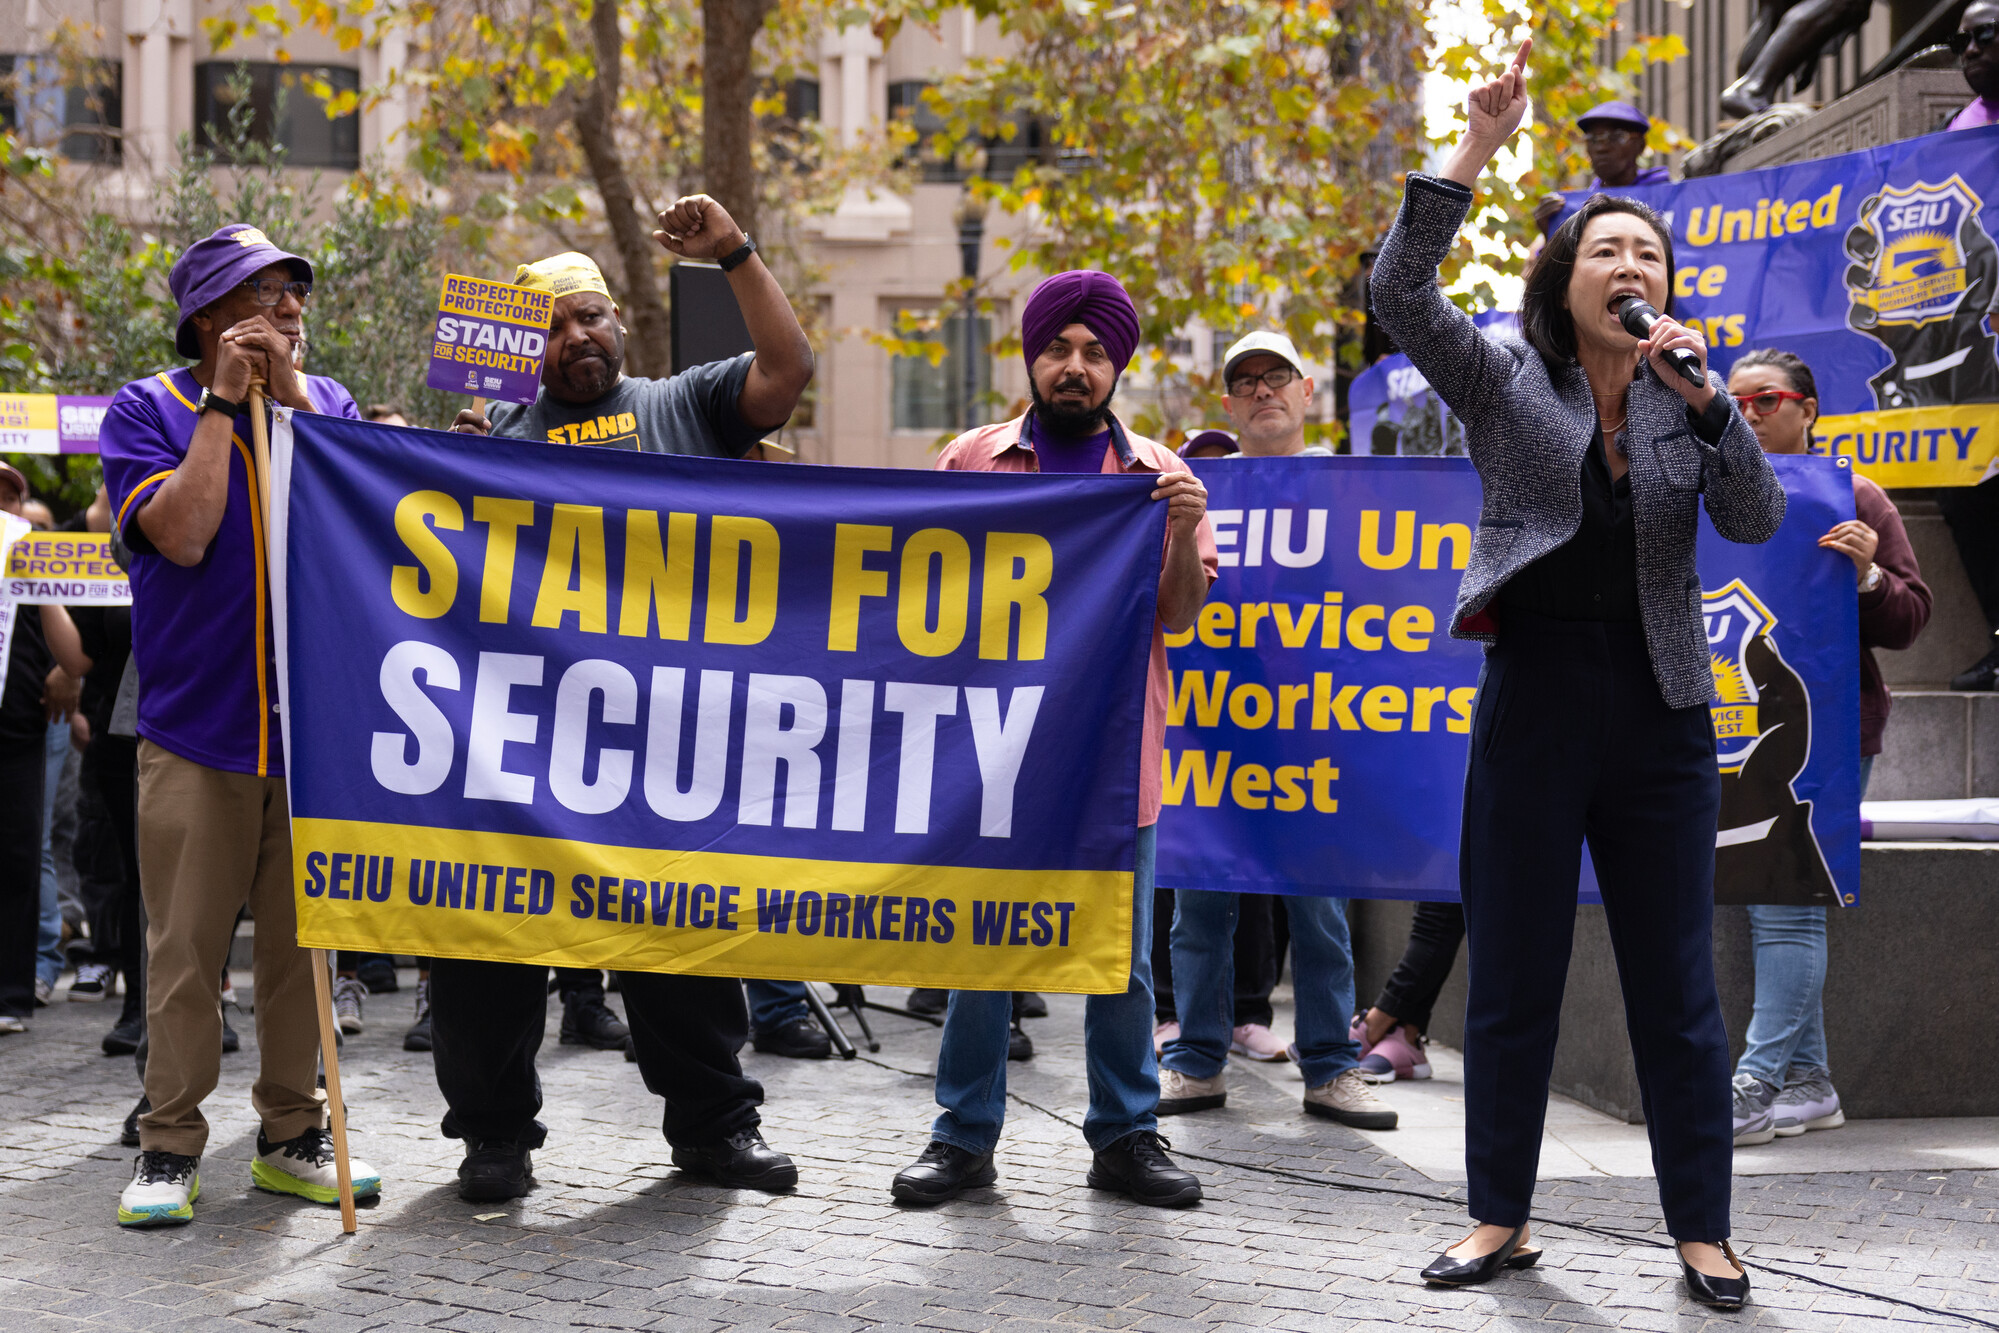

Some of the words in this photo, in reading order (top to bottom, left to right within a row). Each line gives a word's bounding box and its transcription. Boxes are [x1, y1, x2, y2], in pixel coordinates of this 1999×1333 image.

[1686, 183, 1843, 247] United
[1886, 201, 1951, 232] SEIU
[447, 278, 518, 303] RESPECT
[521, 291, 551, 309] THE
[1879, 290, 1929, 309] WORKERS
[1932, 283, 1957, 295] WEST
[1917, 273, 1957, 290] SERVICE
[444, 293, 549, 324] PROTECTORS!
[437, 317, 545, 357] STAND
[434, 345, 453, 357] FOR
[454, 345, 541, 375] SECURITY
[547, 412, 637, 445] STAND
[1208, 509, 1328, 568] EIU
[11, 560, 123, 576] PROTEC
[391, 490, 780, 645] STAND
[828, 523, 1053, 661] FOR
[10, 581, 86, 596] STAND
[1166, 670, 1477, 733] Workers
[371, 640, 1045, 838] SECURITY
[1715, 723, 1743, 734] EST
[1161, 749, 1339, 813] West
[305, 851, 394, 902] SEIU
[408, 858, 555, 915] UNITED
[570, 874, 740, 931] SERVICE
[757, 888, 955, 944] WORKERS
[972, 900, 1075, 947] WEST
